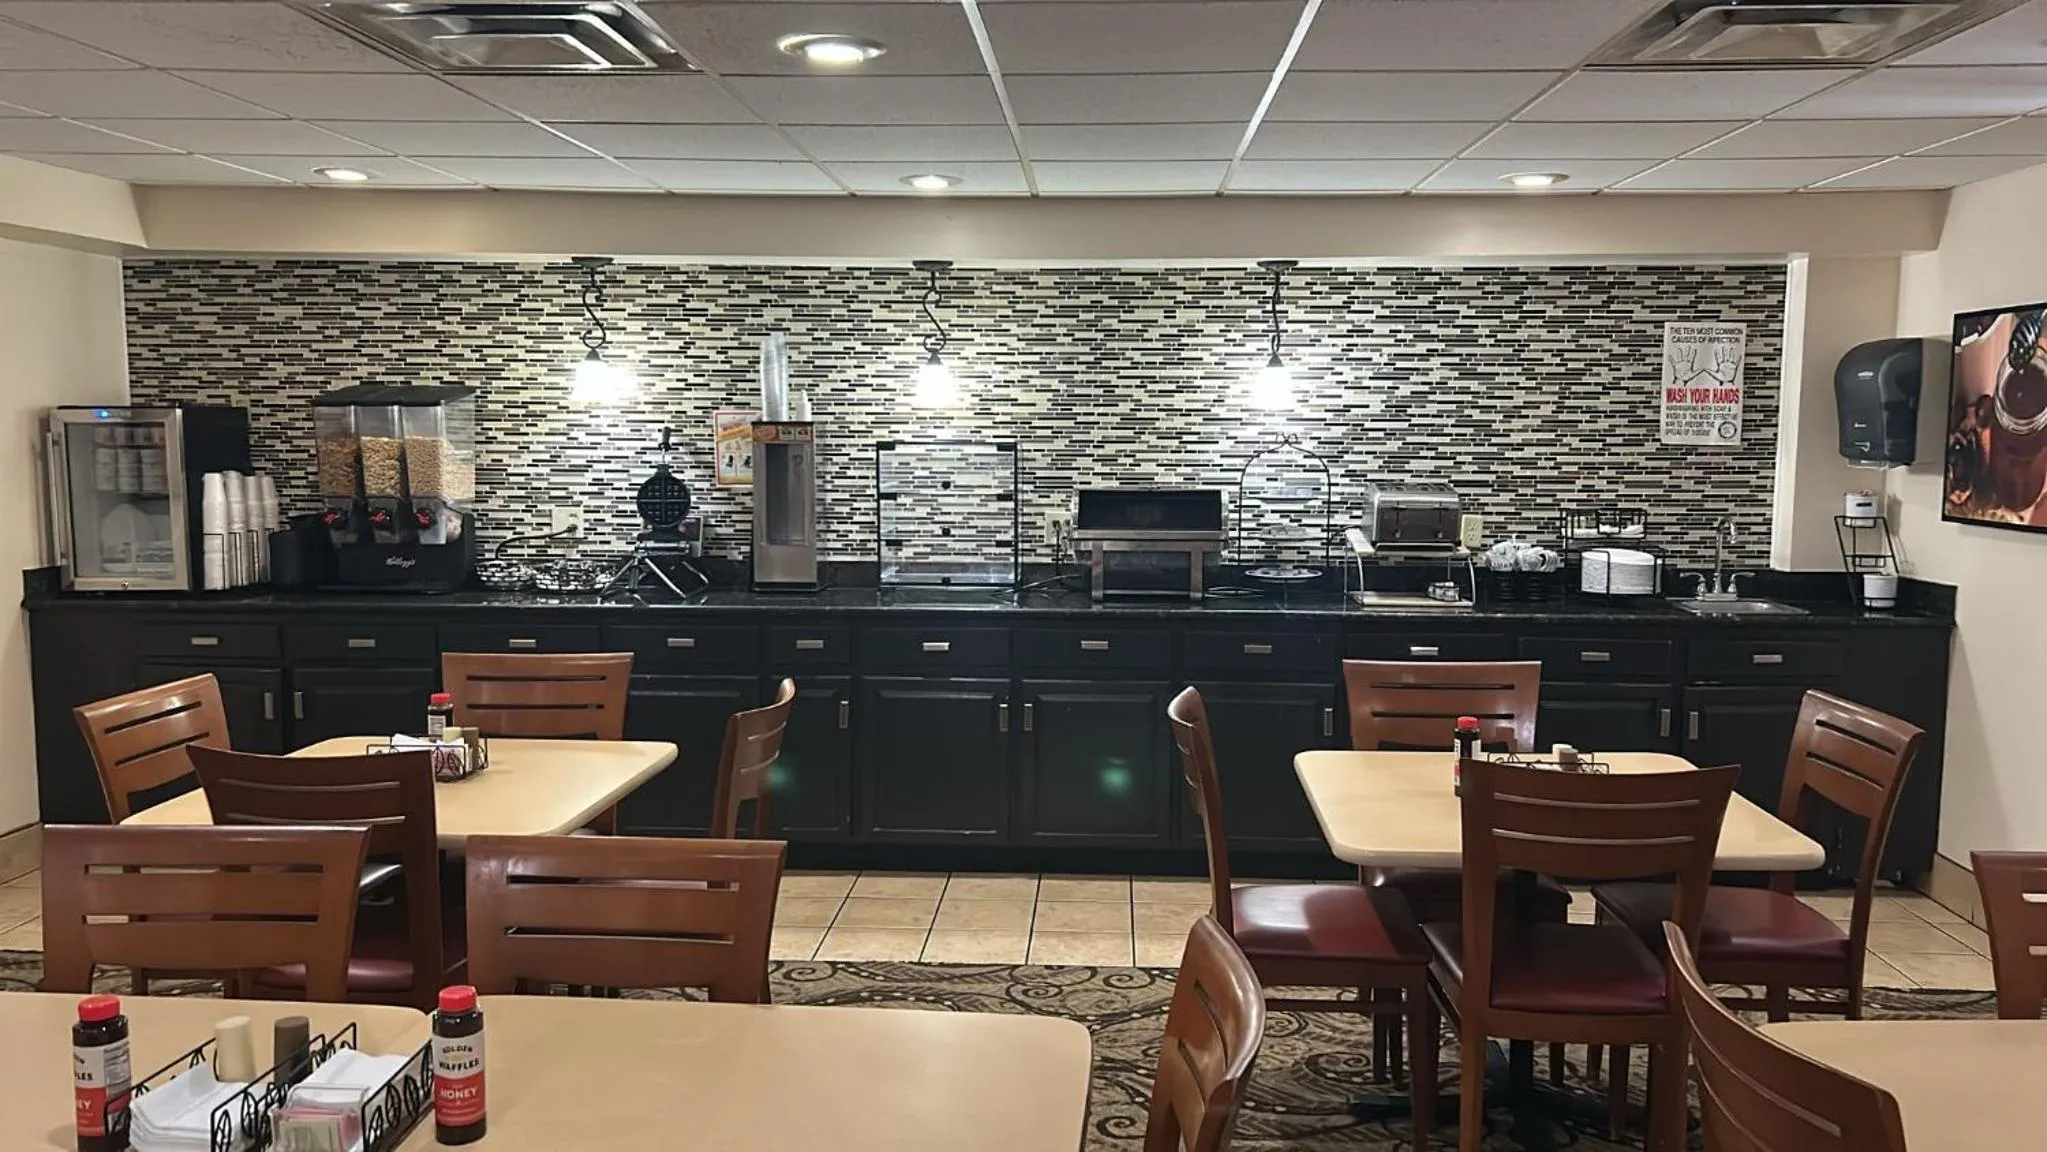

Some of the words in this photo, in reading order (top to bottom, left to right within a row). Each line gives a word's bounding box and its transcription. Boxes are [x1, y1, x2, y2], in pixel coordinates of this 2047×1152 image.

[1670, 327, 1682, 335] THE
[1683, 327, 1695, 335] TEN
[1696, 327, 1714, 335] MOST
[1715, 327, 1743, 335] COMMON
[1672, 335, 1697, 344] CAUSES
[1708, 336, 1741, 344] INFECTION
[1666, 388, 1687, 404] WASH
[1690, 388, 1711, 404] YOUR
[1713, 388, 1740, 404] HANDS
[442, 1044, 473, 1054] GOLDEN
[439, 1058, 480, 1071] WAFFLES
[440, 1086, 478, 1100] HONEY
